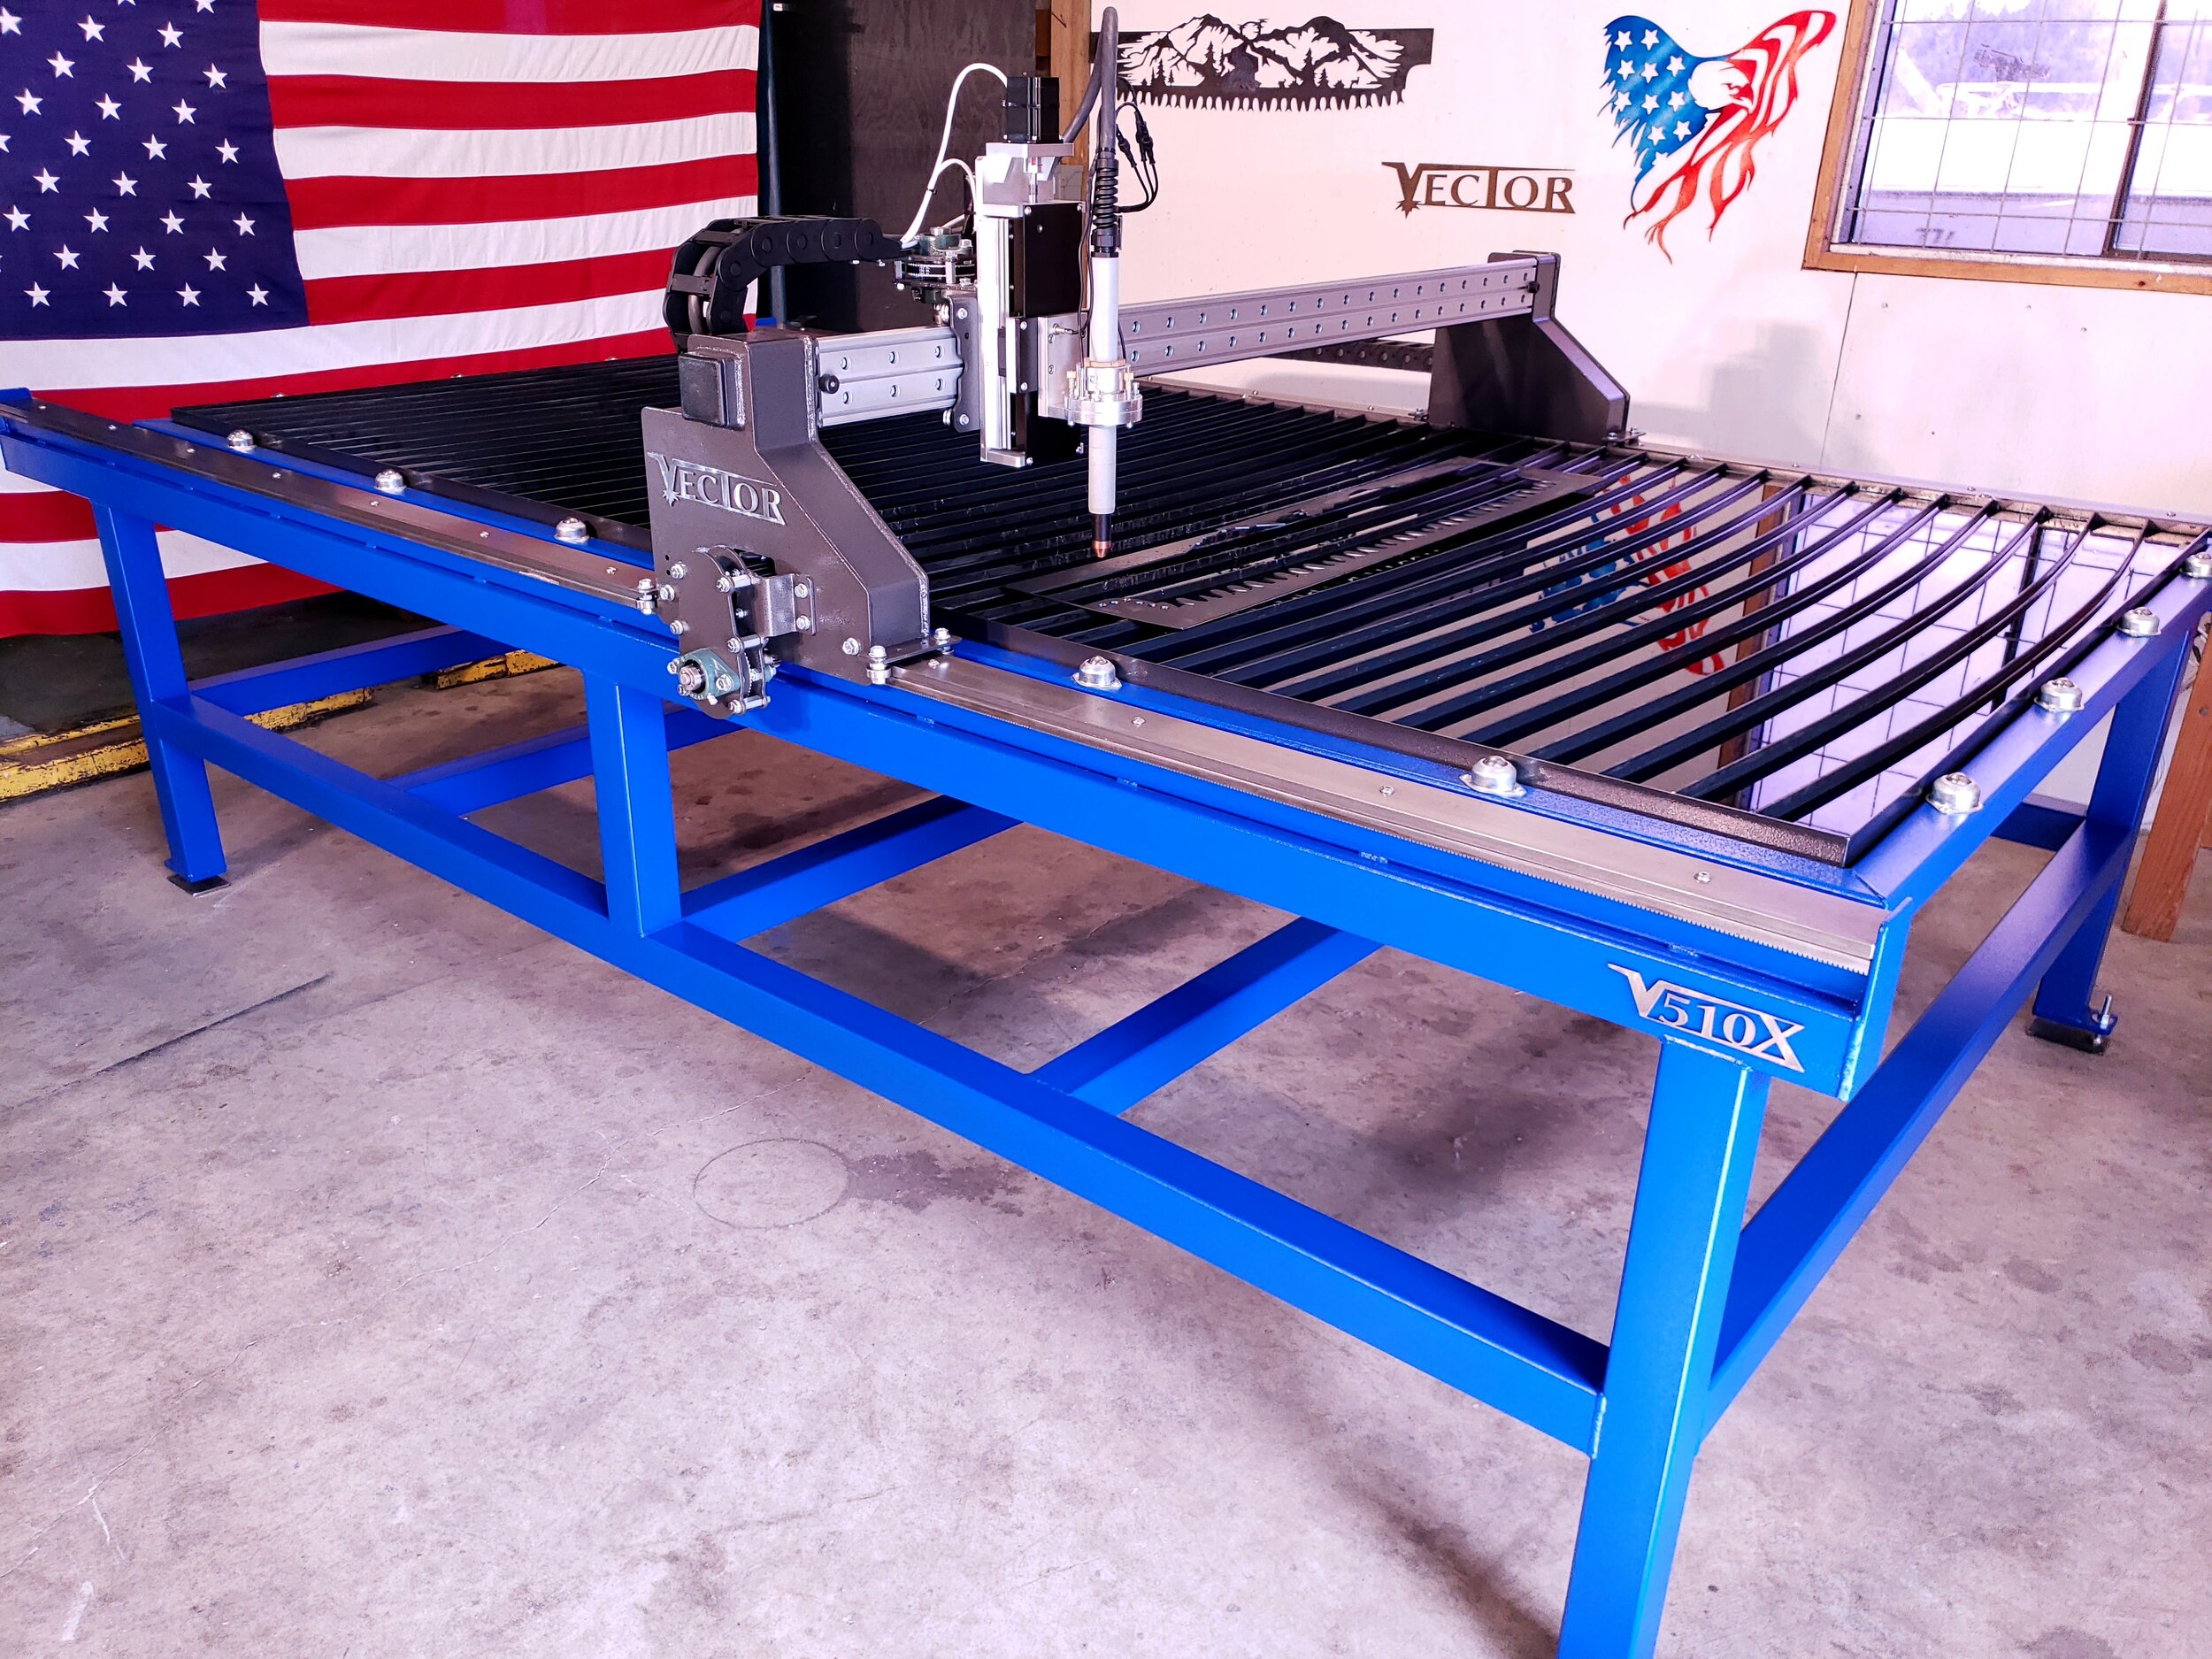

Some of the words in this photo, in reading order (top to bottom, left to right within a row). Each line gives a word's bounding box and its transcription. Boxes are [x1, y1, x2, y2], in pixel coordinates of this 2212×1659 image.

[1381, 162, 1576, 219] VECTOR
[647, 452, 786, 526] VECTOR
[1608, 963, 1805, 1073] V510X
